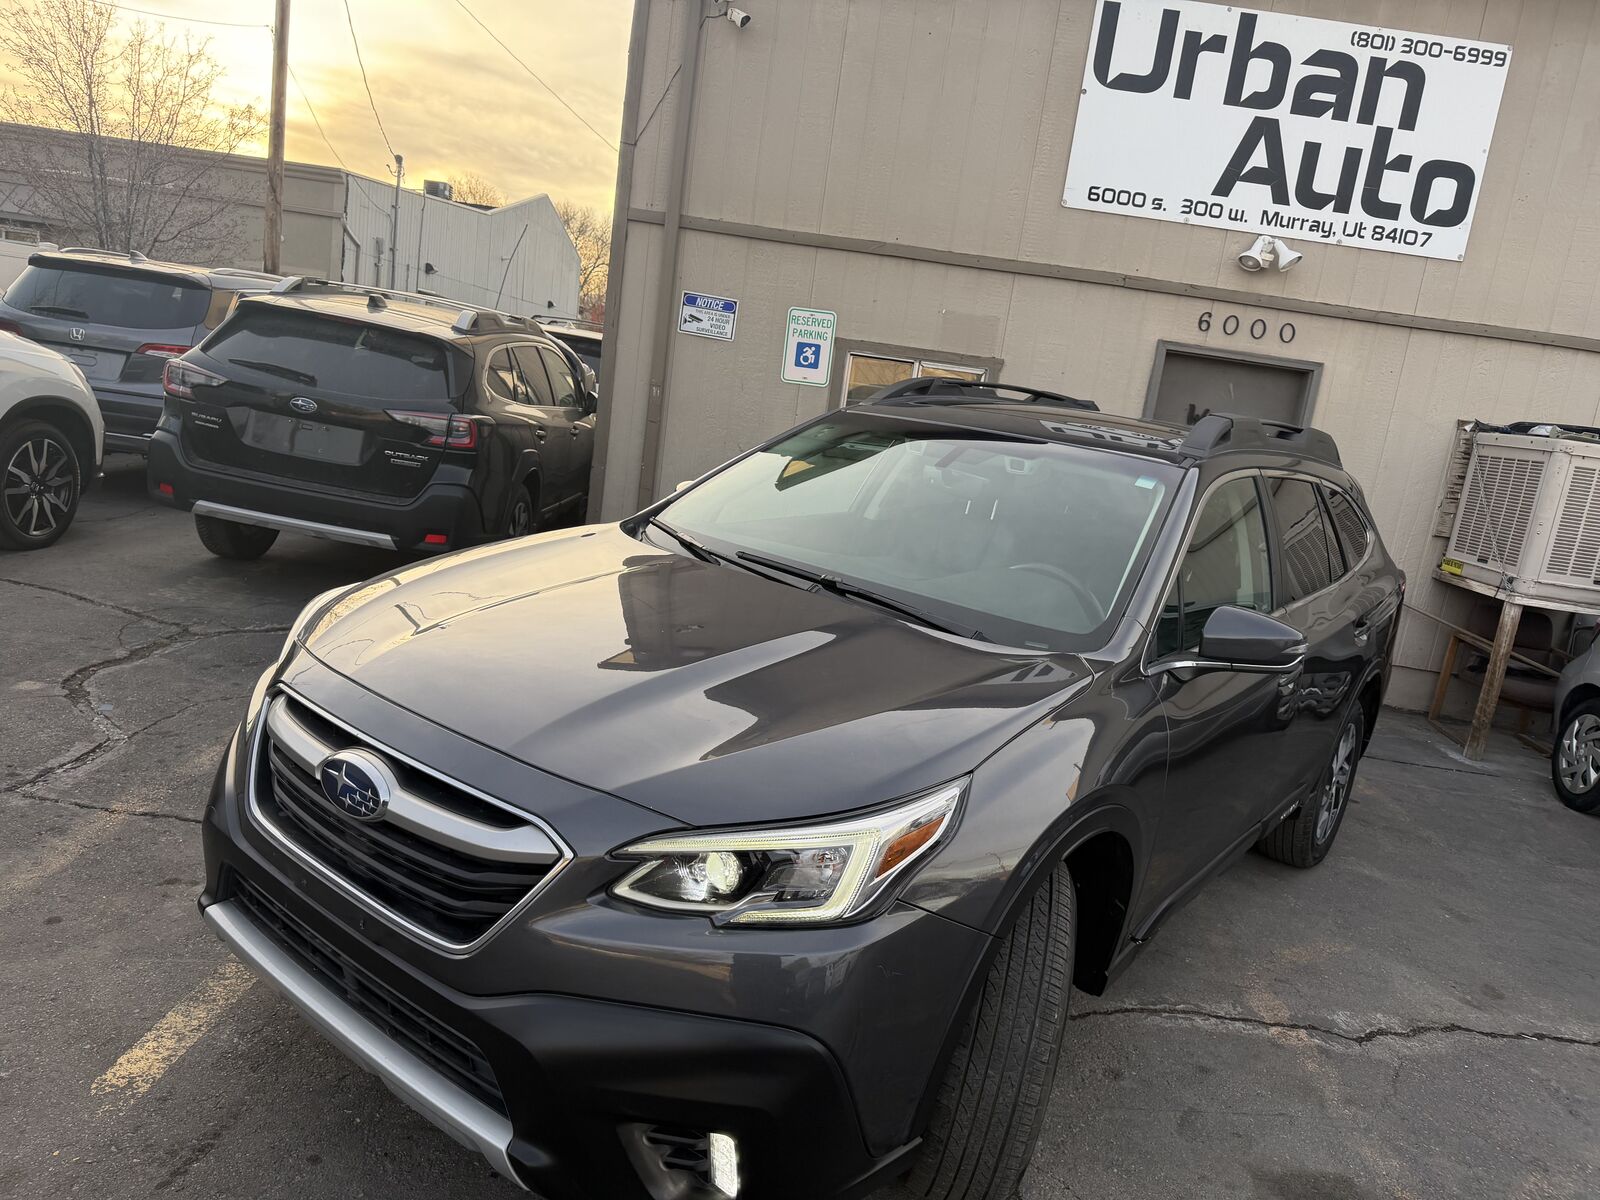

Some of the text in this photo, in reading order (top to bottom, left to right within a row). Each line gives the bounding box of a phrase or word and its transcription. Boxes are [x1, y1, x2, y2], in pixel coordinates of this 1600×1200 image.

[1350, 31, 1508, 68] (801) 300-6999
[1093, 0, 1427, 132] Urban
[1210, 115, 1476, 228] Auto
[1087, 185, 1147, 208] 6000
[1180, 198, 1224, 219] 300
[1259, 209, 1337, 239] Murray,
[1341, 220, 1367, 240] Ut
[1371, 224, 1433, 248] 84107
[695, 297, 725, 310] NOTICE
[709, 322, 726, 331] VIDEO
[715, 317, 730, 326] HOUR
[791, 314, 833, 329] RESERVED
[1197, 311, 1296, 344] 6000
[696, 326, 728, 337] SURVEILLANCE
[792, 328, 828, 342] PARKING
